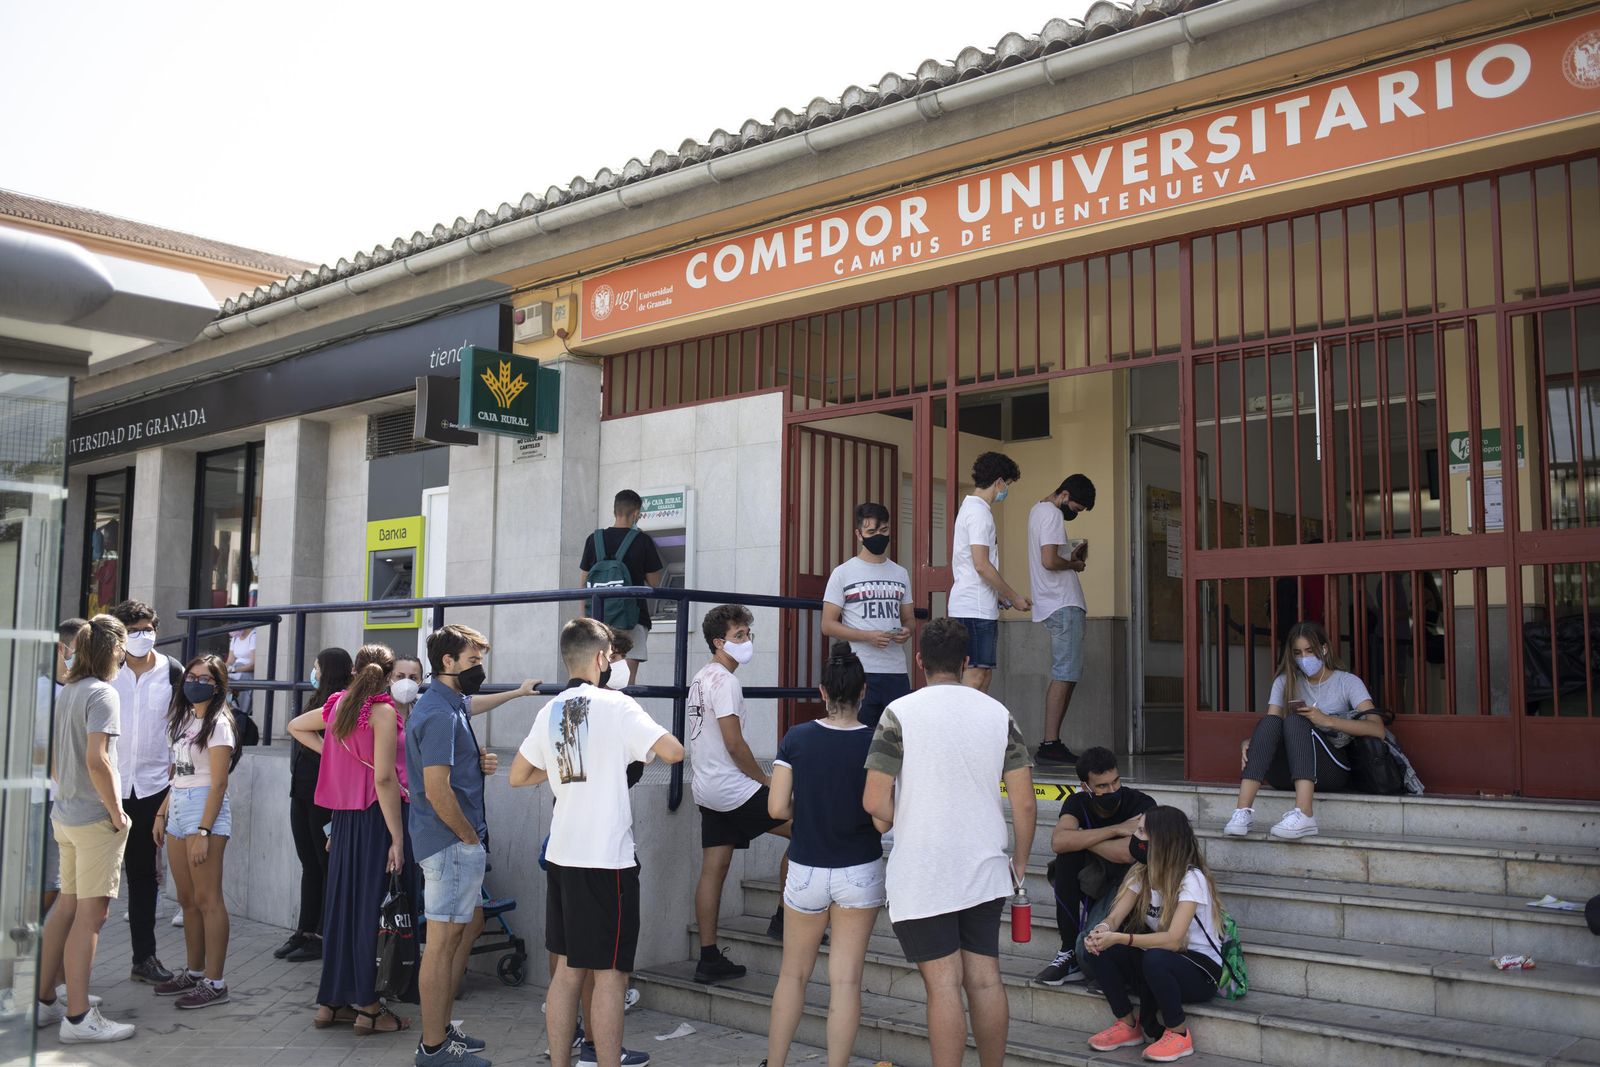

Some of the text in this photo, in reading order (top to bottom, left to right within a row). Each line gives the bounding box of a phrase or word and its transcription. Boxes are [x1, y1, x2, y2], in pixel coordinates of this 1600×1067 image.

[685, 196, 930, 289] COMEDOR
[957, 44, 1531, 223] UNIVERSITARIO
[833, 163, 1256, 275] CAMPUS DE FUENTENUEVA
[615, 288, 636, 311] ugr
[639, 285, 673, 300] Universidad
[638, 298, 673, 312] de Granada
[430, 339, 475, 368] tiend
[128, 422, 142, 441] DE
[145, 407, 207, 437] GRANADA
[477, 411, 529, 427] CAJA RURAL
[651, 498, 664, 506] CAJA
[379, 527, 408, 541] Bankia
[855, 580, 902, 600] TOMMY
[862, 601, 899, 620] JEANS
